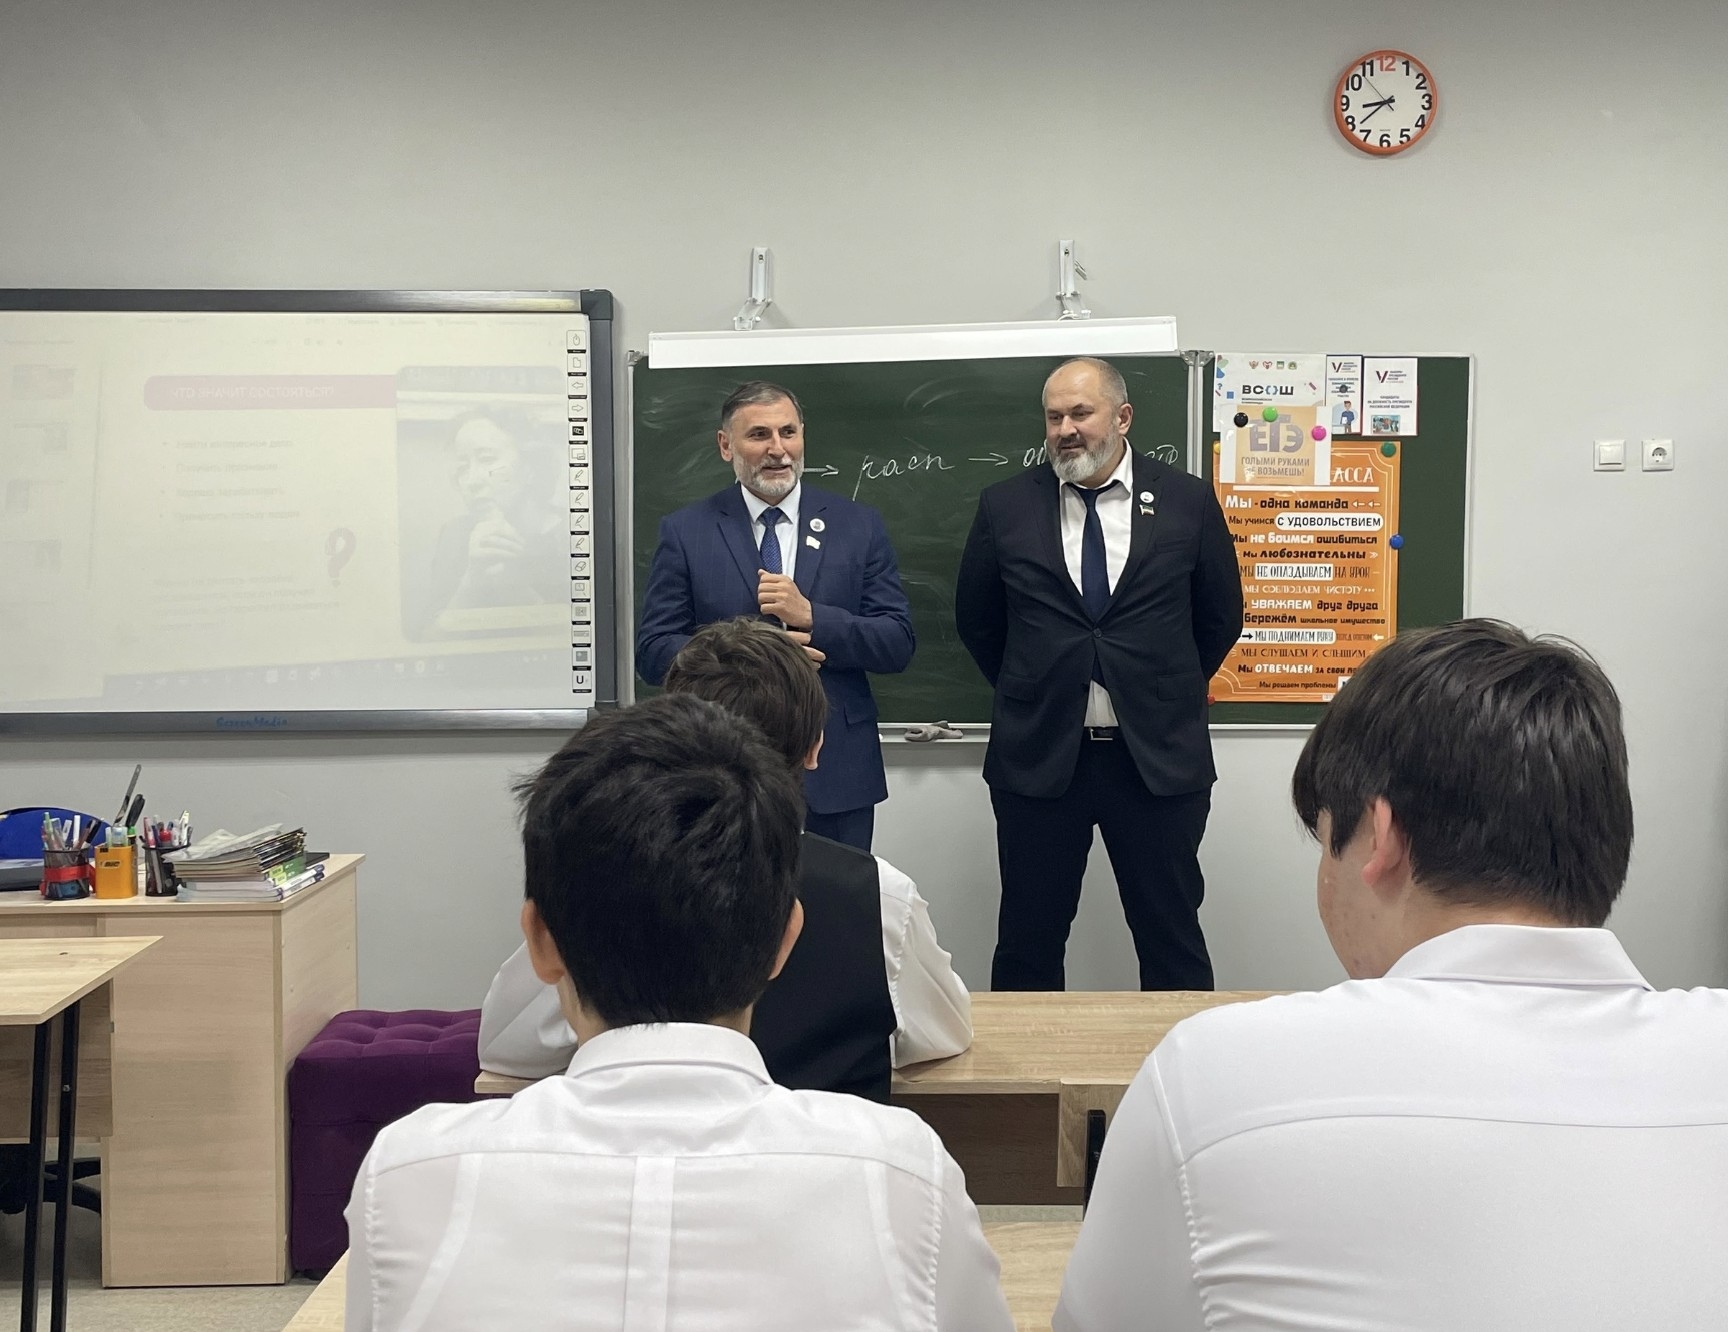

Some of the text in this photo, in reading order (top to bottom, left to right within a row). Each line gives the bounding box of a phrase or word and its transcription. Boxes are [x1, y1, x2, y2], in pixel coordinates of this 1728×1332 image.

[1359, 59, 1374, 77] 11
[1375, 55, 1396, 72] 12
[1401, 60, 1410, 76] 1
[1345, 74, 1362, 91] 10
[1415, 73, 1427, 90] 2
[1341, 95, 1350, 112] 9
[1421, 93, 1433, 111] 3
[1344, 115, 1356, 132] 8
[1415, 114, 1426, 130] 4
[1359, 129, 1371, 142] 7
[1379, 134, 1391, 148] 6
[1399, 128, 1411, 145] 5
[1249, 414, 1304, 453] ЕГЭ
[1241, 457, 1310, 467] ГОЛЫМИ РУКАМИ
[1257, 467, 1305, 476] ВОЗЬМЕШЬ!
[1333, 467, 1374, 483] АССА
[1225, 495, 1252, 509] Мы
[1260, 498, 1290, 509] одна
[1295, 498, 1349, 509] команда
[1228, 516, 1243, 524] Мы
[1244, 518, 1274, 527] учимся
[1287, 517, 1381, 528] УДОВОЛЬСТВИЕМ
[1250, 534, 1266, 544] не
[1267, 532, 1314, 544] боимся
[1317, 534, 1377, 544] ошибиться
[1260, 548, 1366, 559] любознательны
[1257, 566, 1268, 577] НЕ
[1270, 566, 1332, 578] ОПАЗДЫВАЕМ
[1334, 566, 1347, 578] НА
[1349, 566, 1370, 578] УРОК
[1244, 585, 1362, 594] МЫ СОБЛЮДАЕМ ЧИСТОТУ
[1251, 599, 1312, 610] УВАЖАЕМ
[1317, 600, 1342, 611] друг
[1347, 600, 1378, 611] друга
[1340, 618, 1386, 626] имущество
[1255, 631, 1266, 641] МЫ
[1268, 631, 1315, 642] ПОДНИМАЕМ
[1241, 648, 1366, 657] МЫ СЛУШАЕМ И СЛЫШИМ
[1238, 664, 1252, 673] Мы
[1255, 664, 1313, 673] ОТВЕЧАЕМ
[1301, 681, 1336, 689] проблемы
